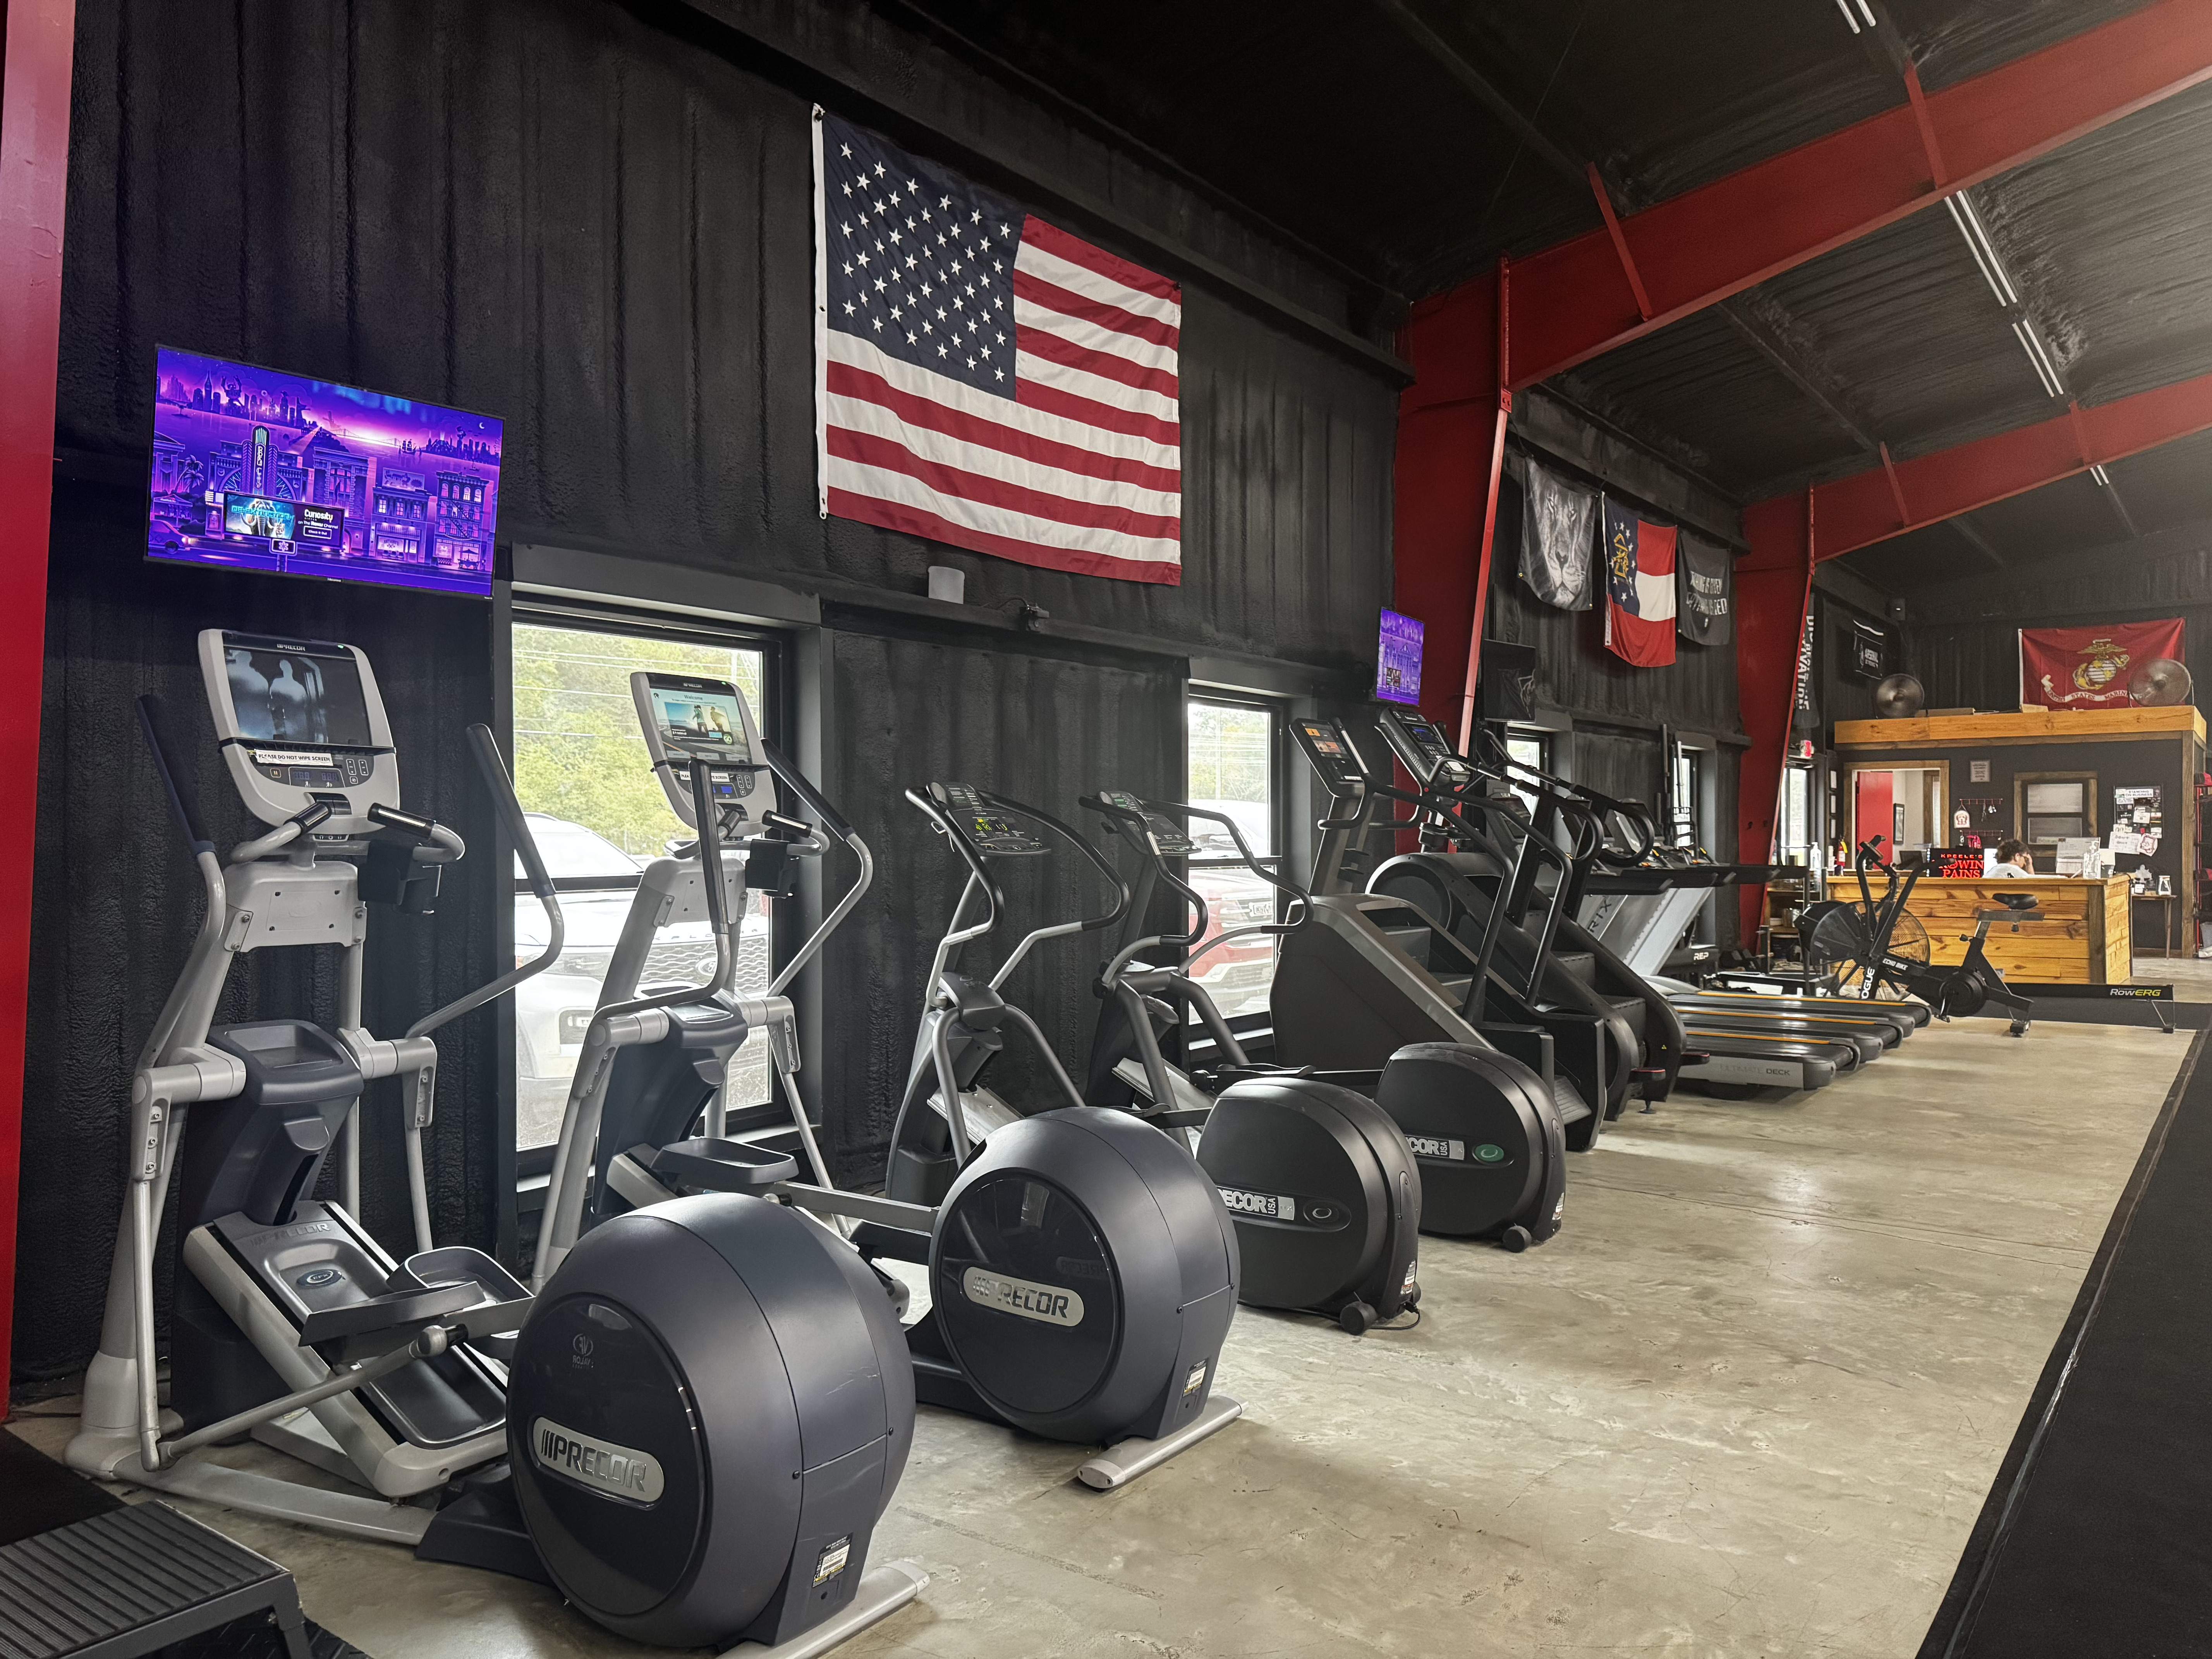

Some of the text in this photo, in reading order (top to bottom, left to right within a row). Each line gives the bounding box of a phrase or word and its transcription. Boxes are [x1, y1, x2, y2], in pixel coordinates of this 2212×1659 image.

[304, 509, 333, 523] Curiosity
[1942, 869, 1980, 878] PAINS
[1587, 899, 1612, 933] RIX
[1693, 952, 1709, 960] REP
[1882, 958, 1908, 971] ECHO BIKE
[1861, 967, 1875, 1000] OGUE
[1405, 1137, 1440, 1156] COR
[1440, 1141, 1448, 1156] USA
[1217, 1188, 1267, 1214] ECOR
[1267, 1197, 1276, 1214] USA
[985, 1279, 1069, 1319] PRECOR
[554, 1435, 646, 1492] PRECOR
